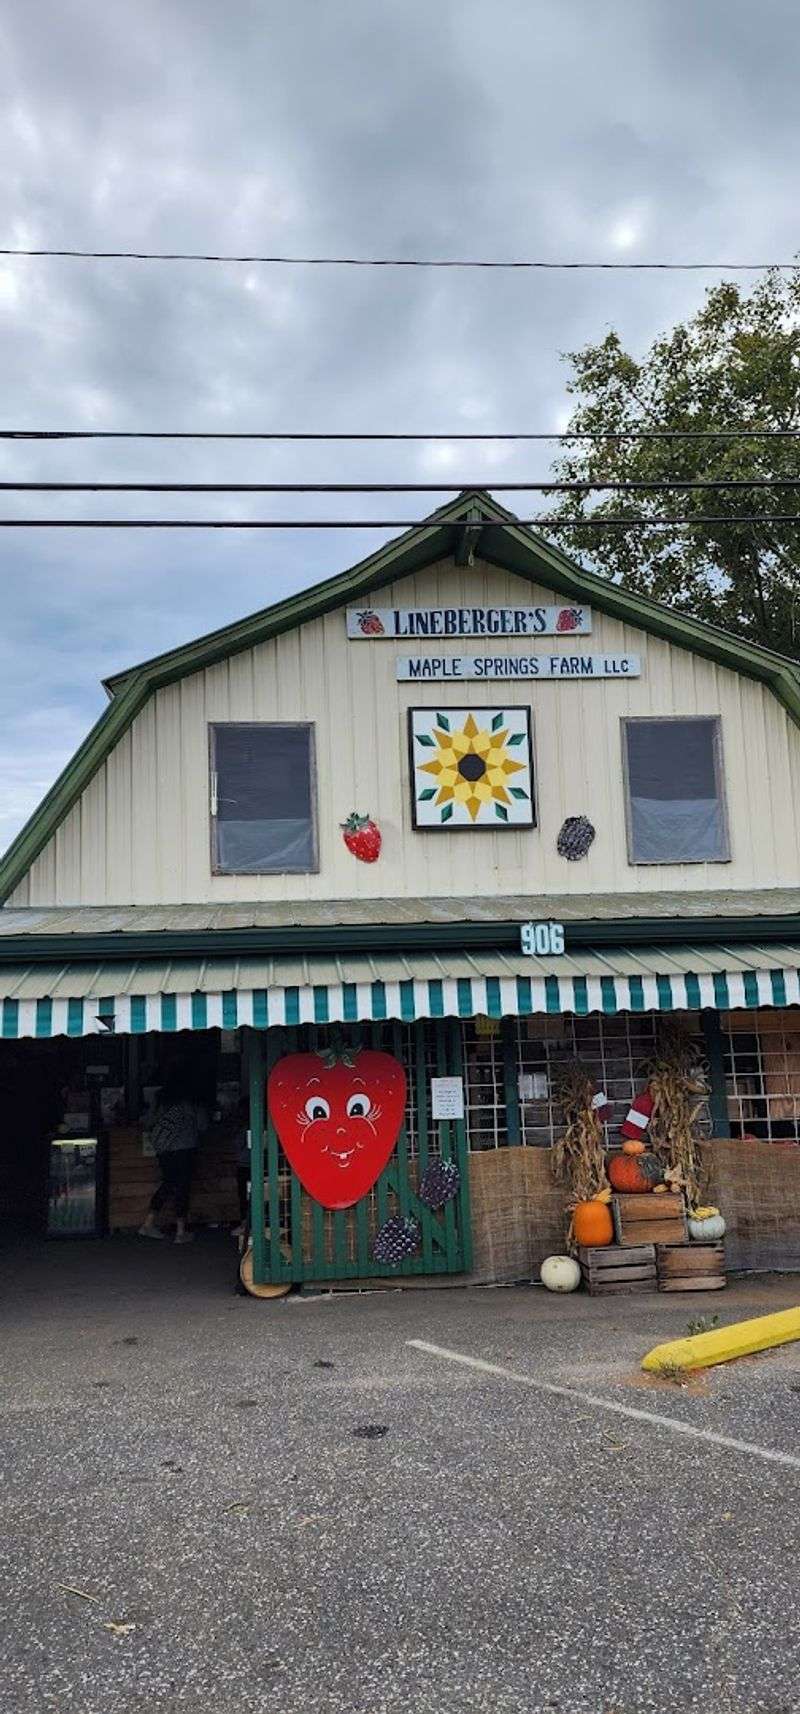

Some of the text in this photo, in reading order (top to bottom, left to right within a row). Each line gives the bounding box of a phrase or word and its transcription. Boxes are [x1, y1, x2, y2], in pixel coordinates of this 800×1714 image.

[393, 608, 547, 635] LINEBERGER'S
[408, 656, 629, 677] MAPLE SPRINGS FARM LLC
[521, 923, 565, 955] 906
